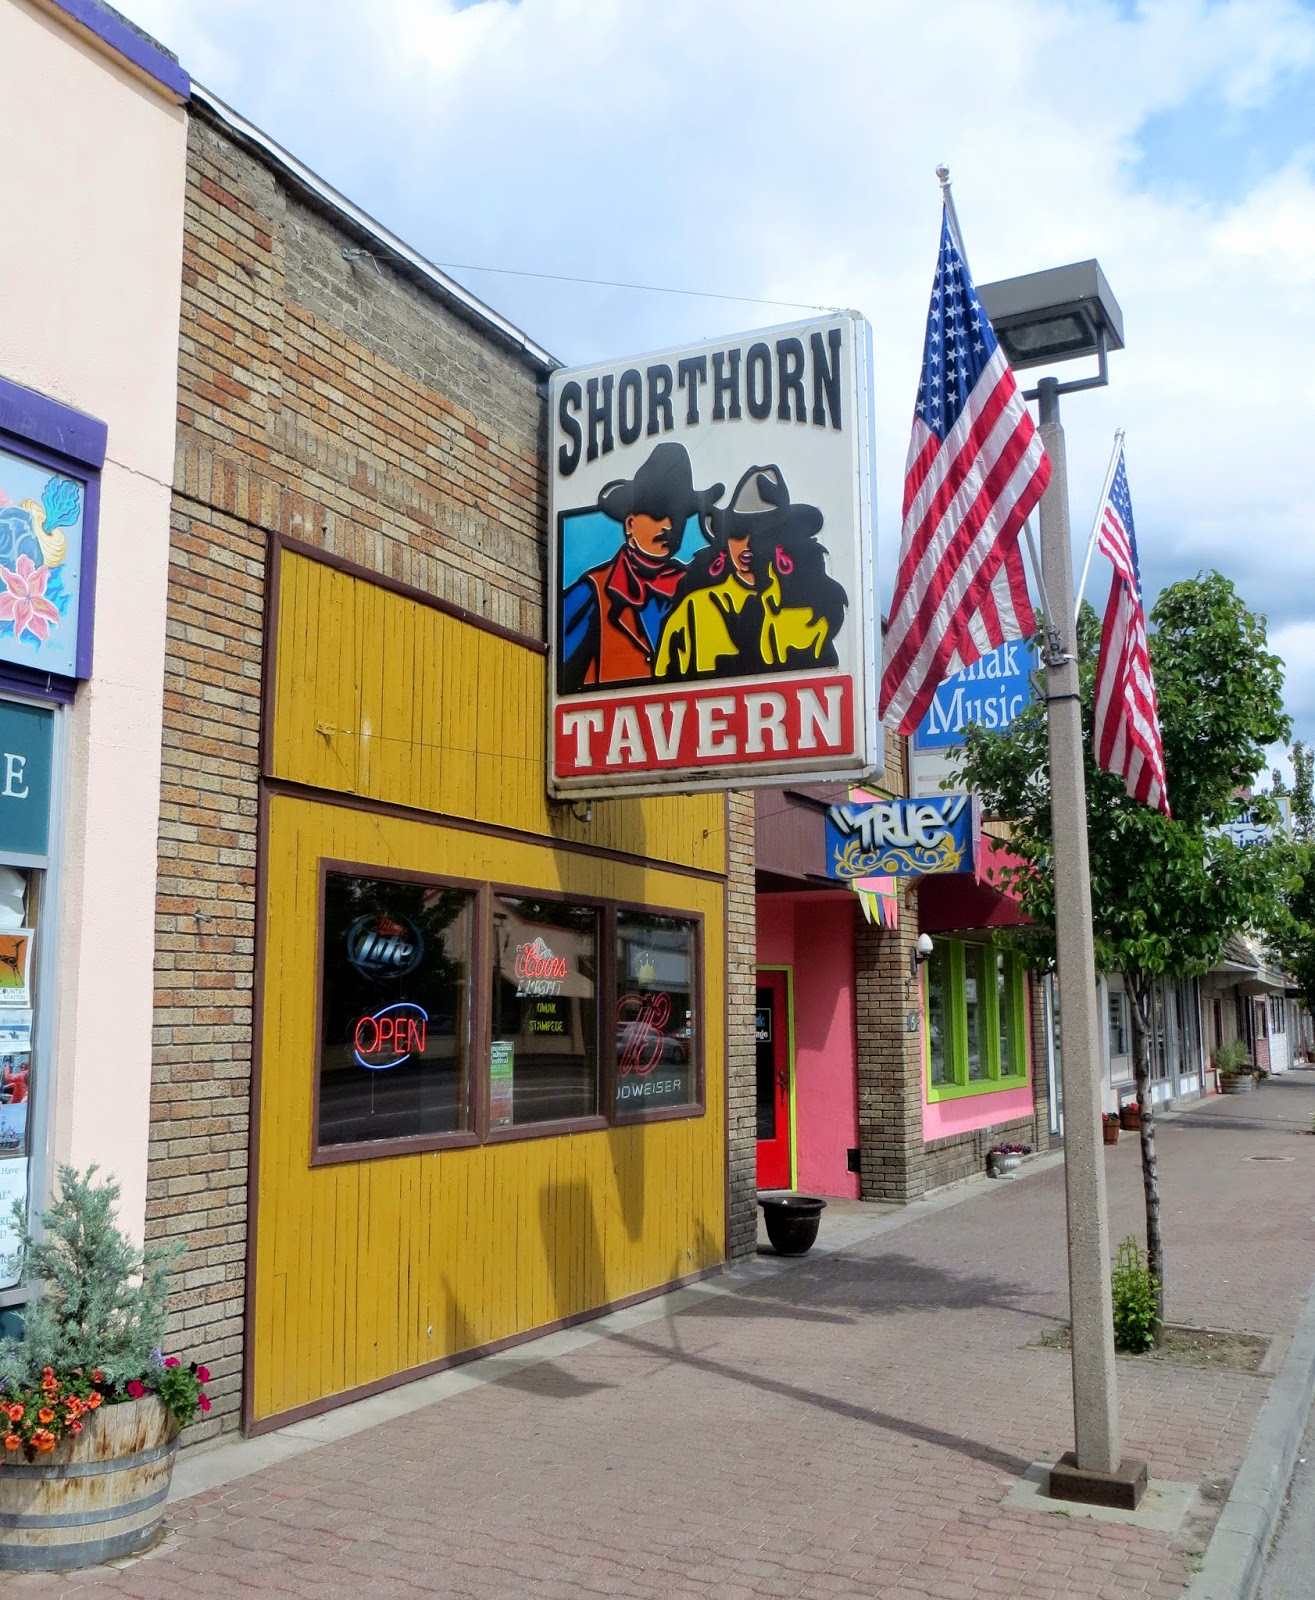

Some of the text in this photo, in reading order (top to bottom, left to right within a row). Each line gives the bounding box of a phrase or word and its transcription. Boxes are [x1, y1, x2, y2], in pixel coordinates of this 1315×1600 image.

[558, 327, 842, 477] SHORTHORN
[562, 684, 844, 768] TAVERN
[927, 684, 1024, 735] Music
[354, 931, 414, 969] Lite
[523, 943, 568, 978] Coors
[528, 1020, 564, 1032] STAMPEDE
[536, 1002, 557, 1014] OMAK
[355, 1016, 427, 1053] OPEN
